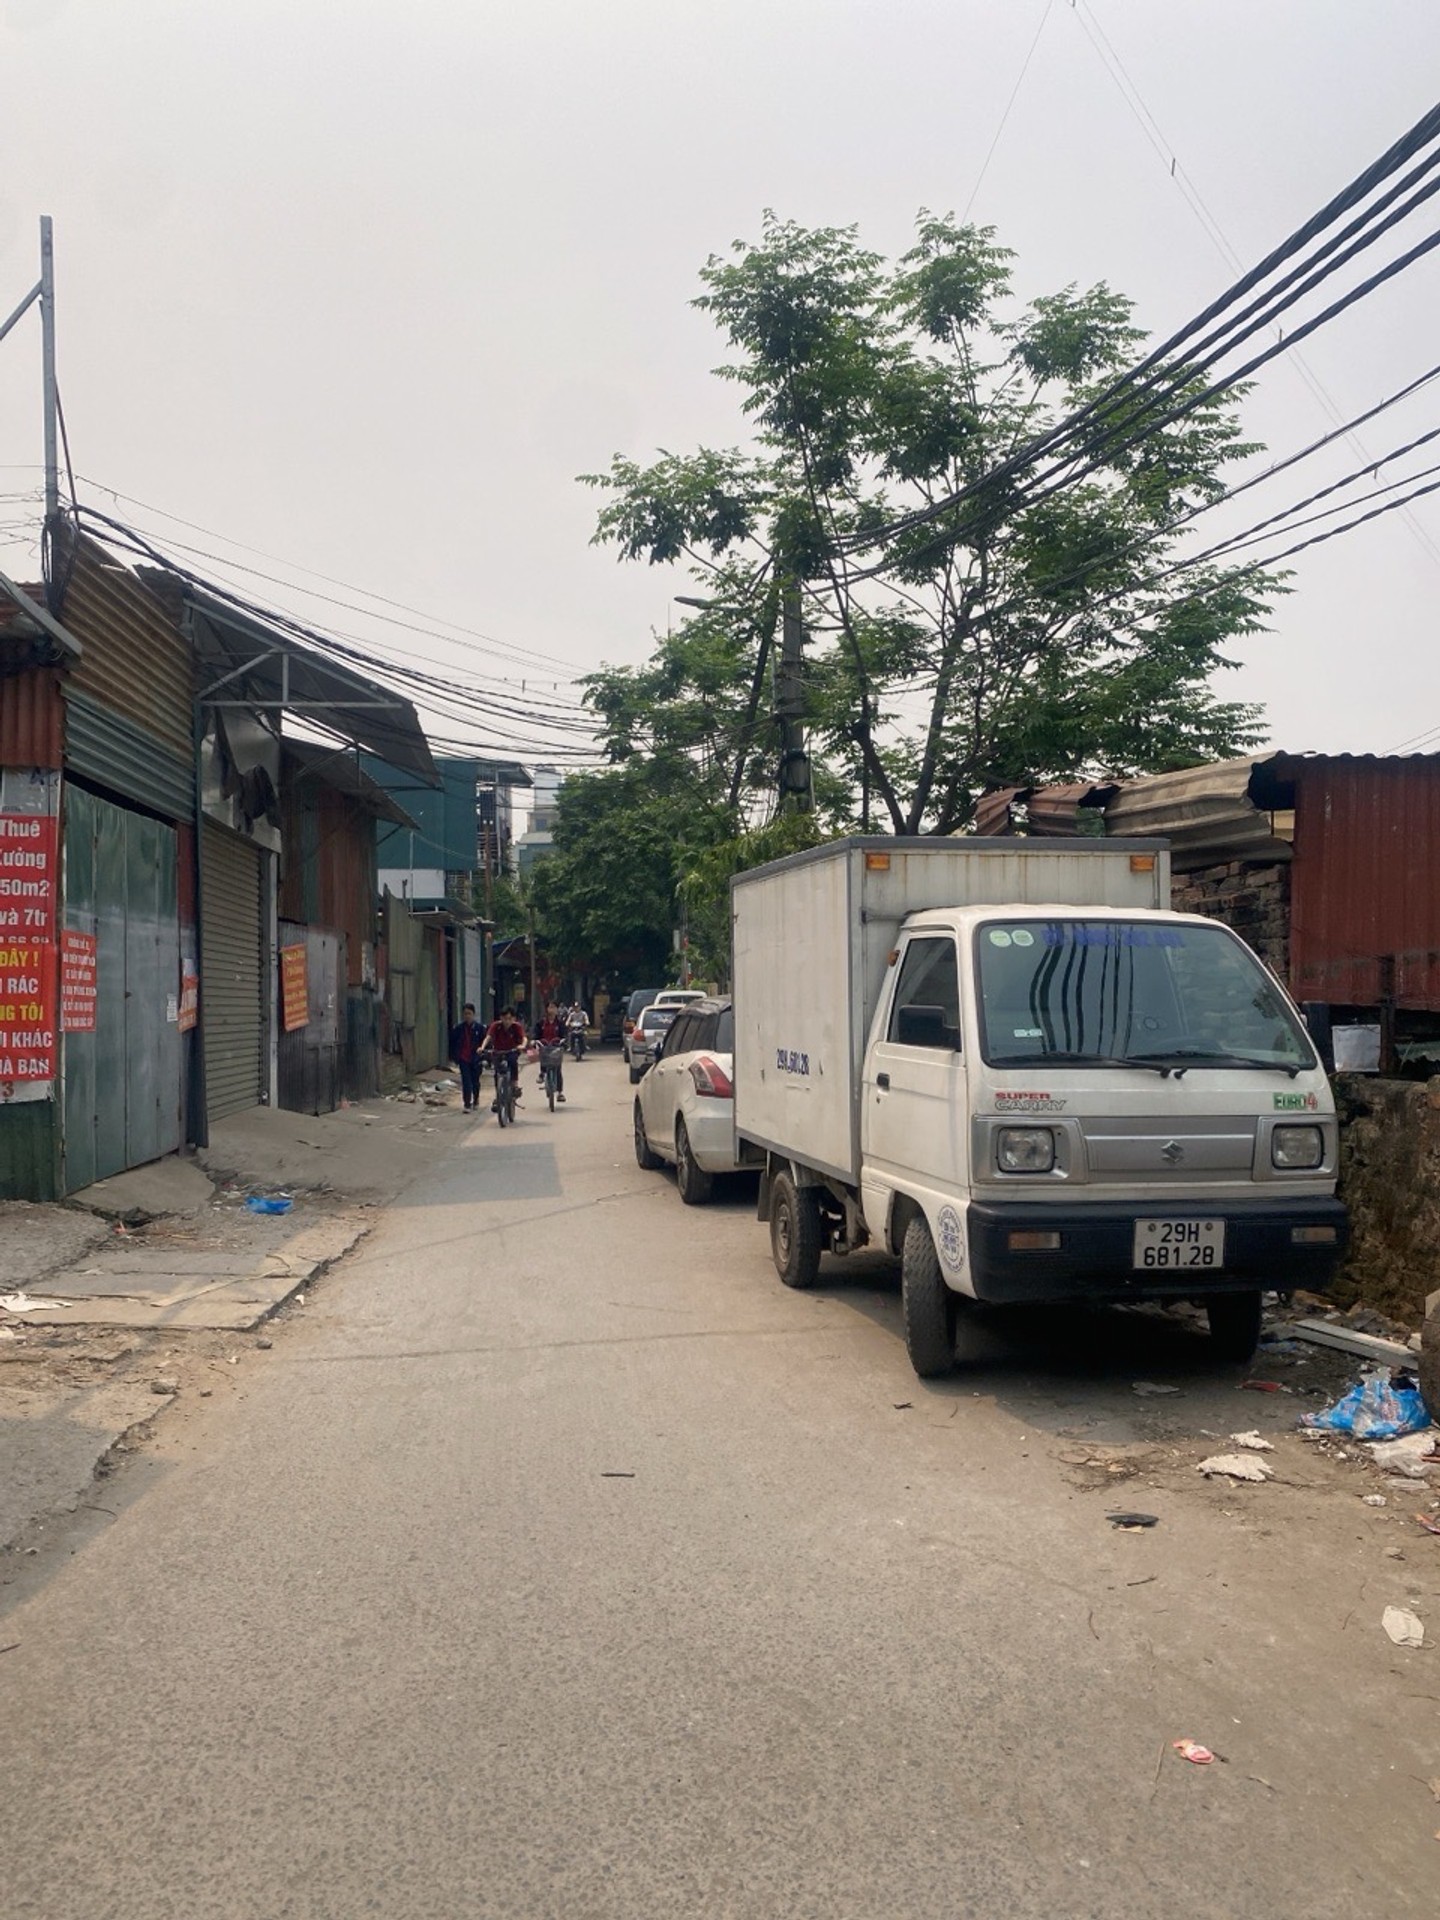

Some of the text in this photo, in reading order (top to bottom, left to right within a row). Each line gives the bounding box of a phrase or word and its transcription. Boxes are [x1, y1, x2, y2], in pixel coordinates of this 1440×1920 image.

[7, 974, 39, 994] RÁC
[19, 1001, 43, 1021] TÔI
[12, 1028, 53, 1048] KHÁC
[18, 1058, 50, 1078] BẠN
[994, 1091, 1052, 1100] SUPER
[1160, 1222, 1200, 1243] 29H
[1144, 1245, 1215, 1267] 681.28
